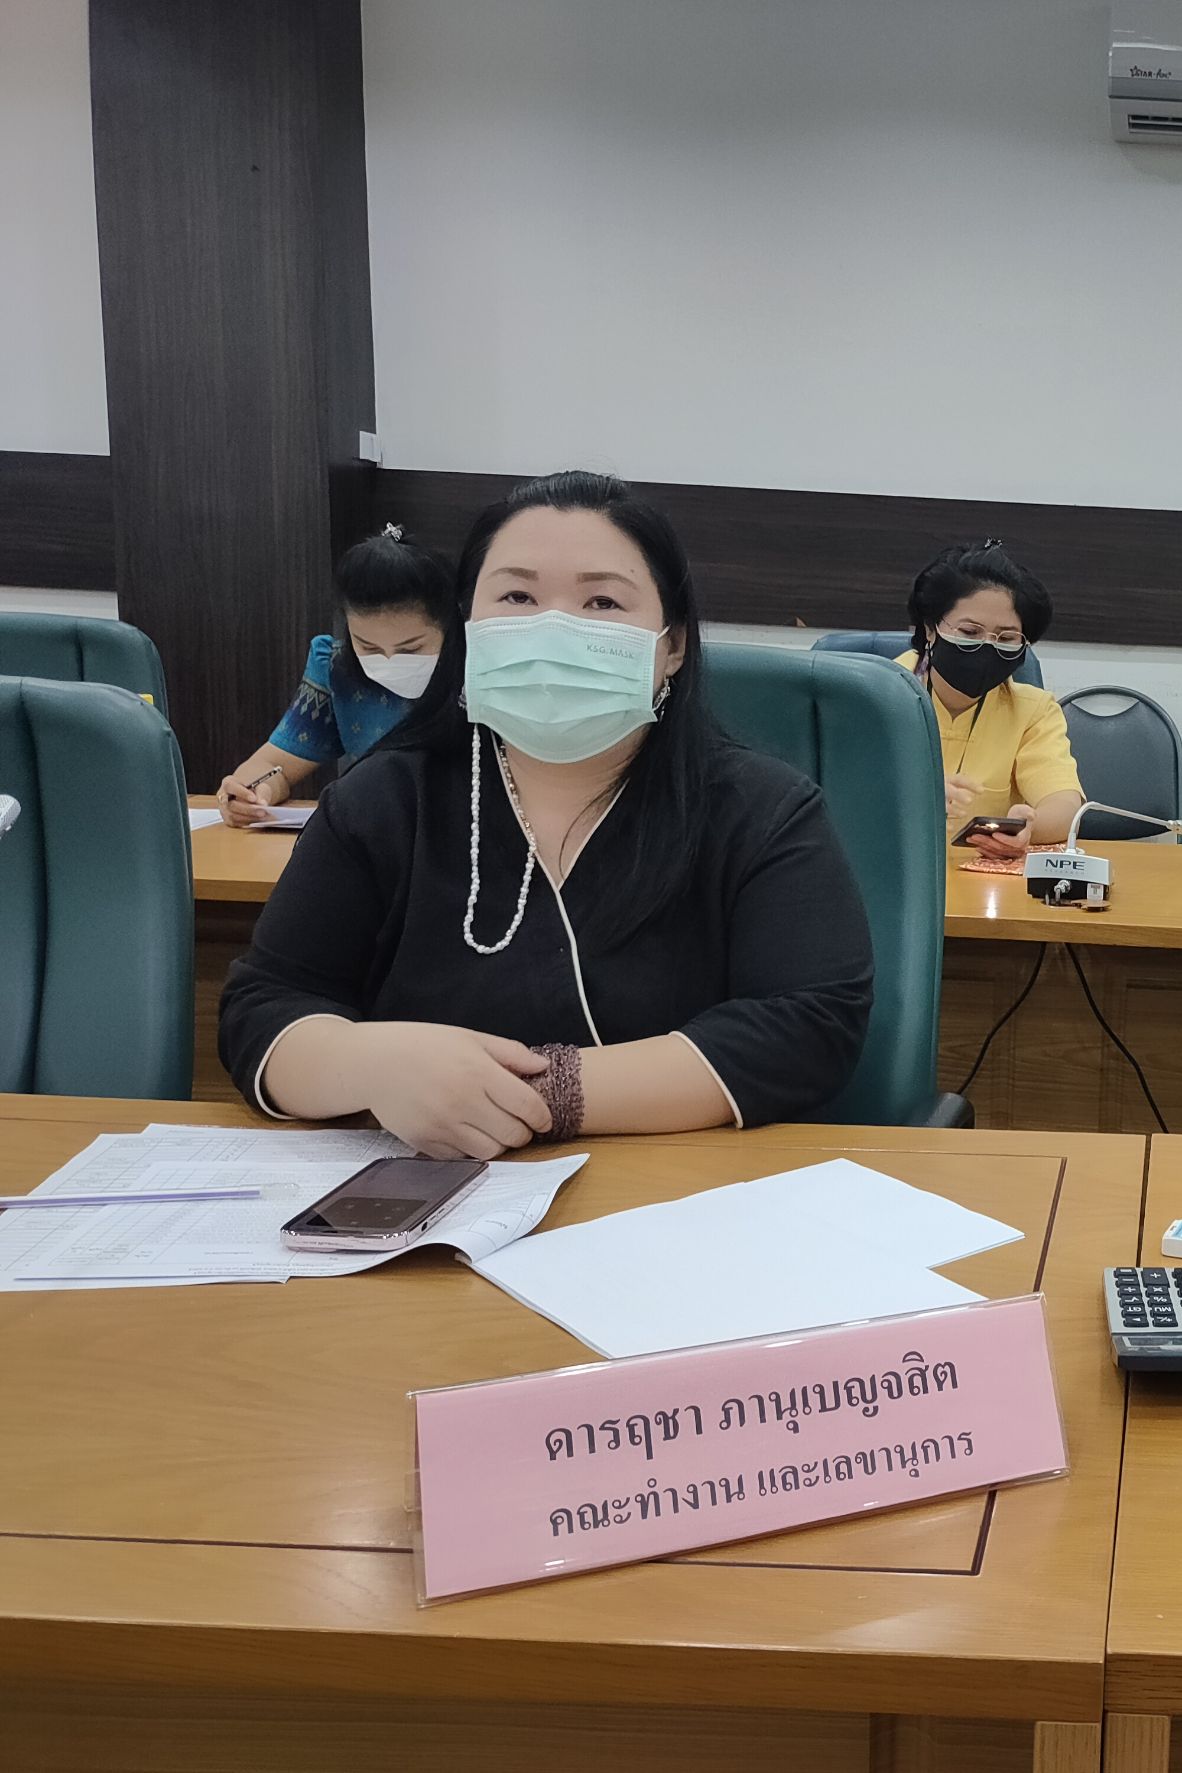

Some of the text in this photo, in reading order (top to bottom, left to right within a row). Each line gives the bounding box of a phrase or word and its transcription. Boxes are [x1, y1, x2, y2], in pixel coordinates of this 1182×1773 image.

[1045, 858, 1086, 871] NPE
[545, 1350, 960, 1461] ดารฤชา ภานุเบญจสิต
[549, 1429, 976, 1537] คณะทำงาน และเลขานุการ
